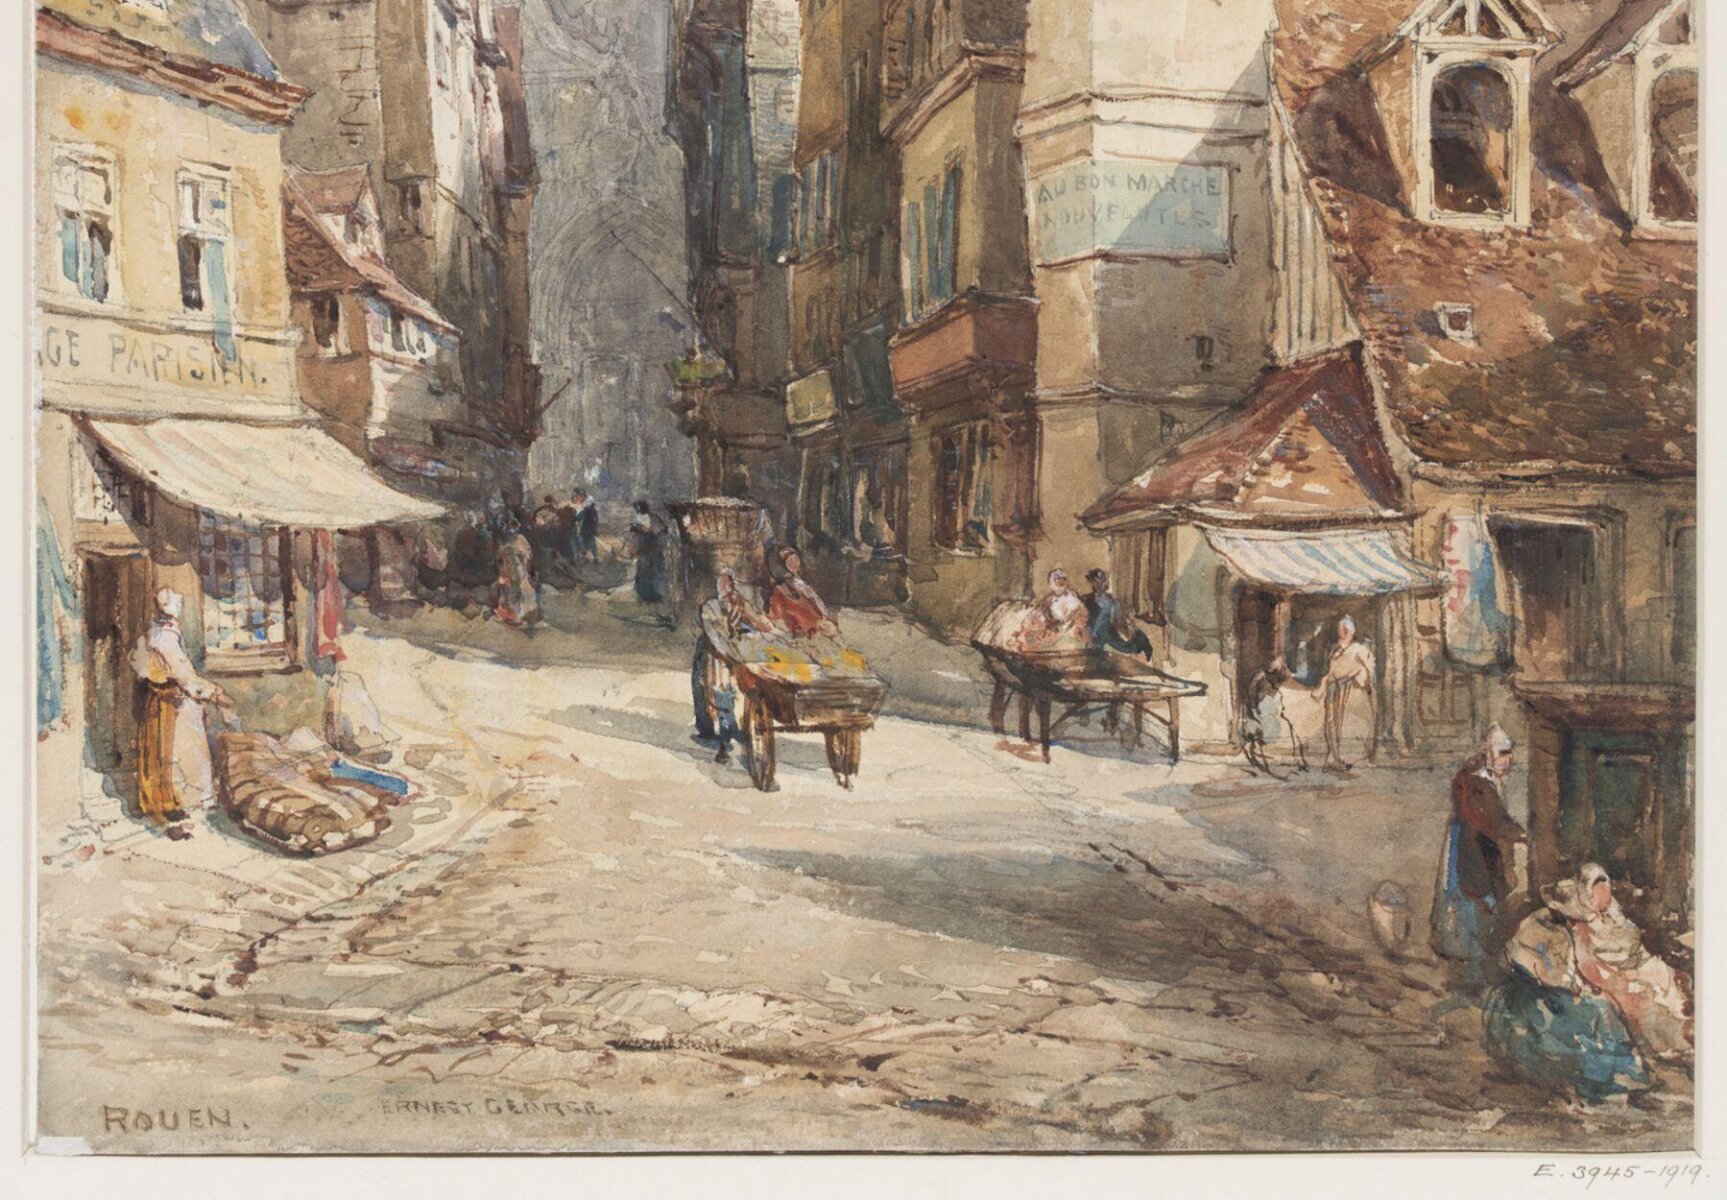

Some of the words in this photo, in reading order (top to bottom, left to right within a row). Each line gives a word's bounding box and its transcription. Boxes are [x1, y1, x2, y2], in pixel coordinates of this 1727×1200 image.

[1037, 178, 1067, 203] AU
[1075, 174, 1116, 192] BON
[1127, 173, 1222, 197] MARCHE
[382, 1099, 473, 1116] ERNEST
